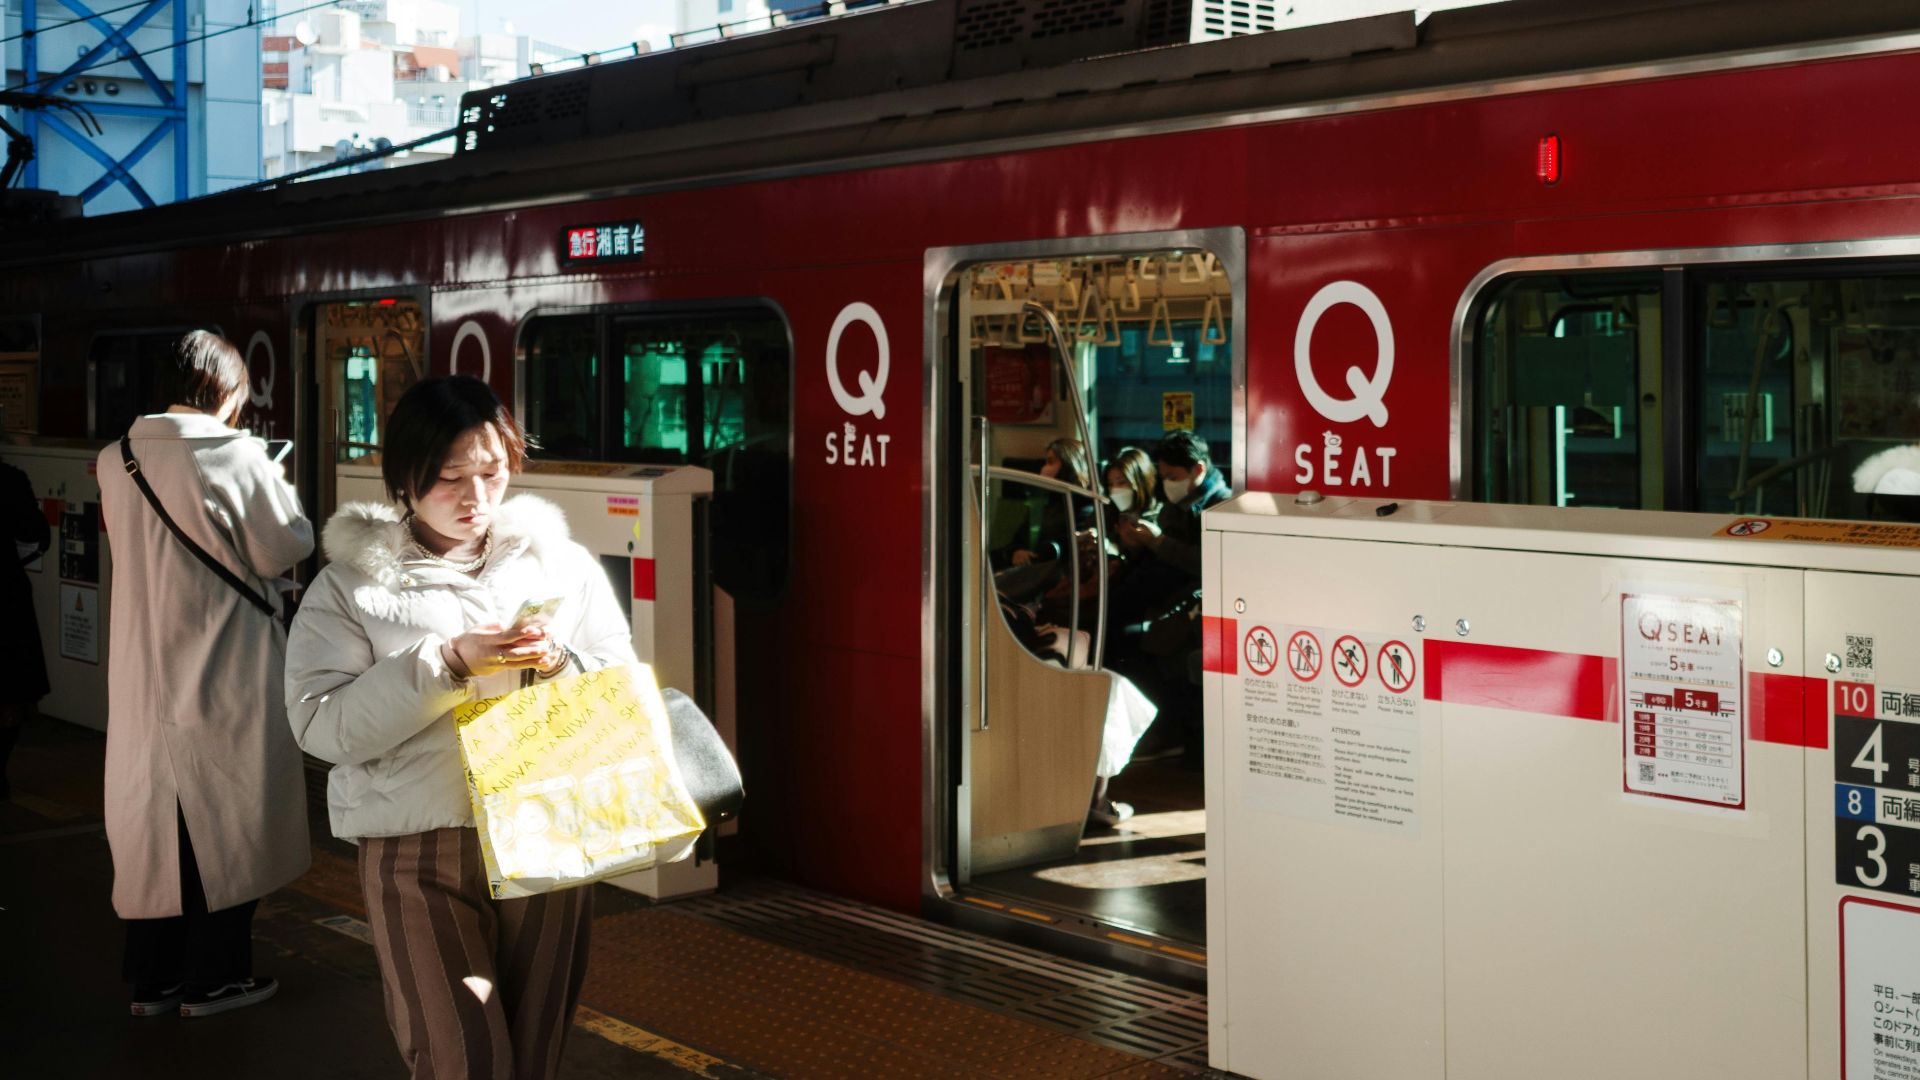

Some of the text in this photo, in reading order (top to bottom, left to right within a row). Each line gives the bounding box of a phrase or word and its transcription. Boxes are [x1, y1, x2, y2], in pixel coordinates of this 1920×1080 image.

[570, 224, 645, 256] 急行 湘南台
[246, 330, 276, 411] Q
[826, 302, 890, 420] Q
[1294, 281, 1395, 428] Q
[826, 432, 891, 467] SEAT
[1295, 444, 1397, 487] SEAT
[1638, 611, 1723, 646] Q SEAT
[1840, 686, 1868, 712] 10
[508, 698, 568, 750] SHONAN
[537, 708, 597, 753] TANIWA
[1850, 722, 1889, 783] 4
[1848, 790, 1862, 815] 8
[1856, 825, 1887, 887] 3
